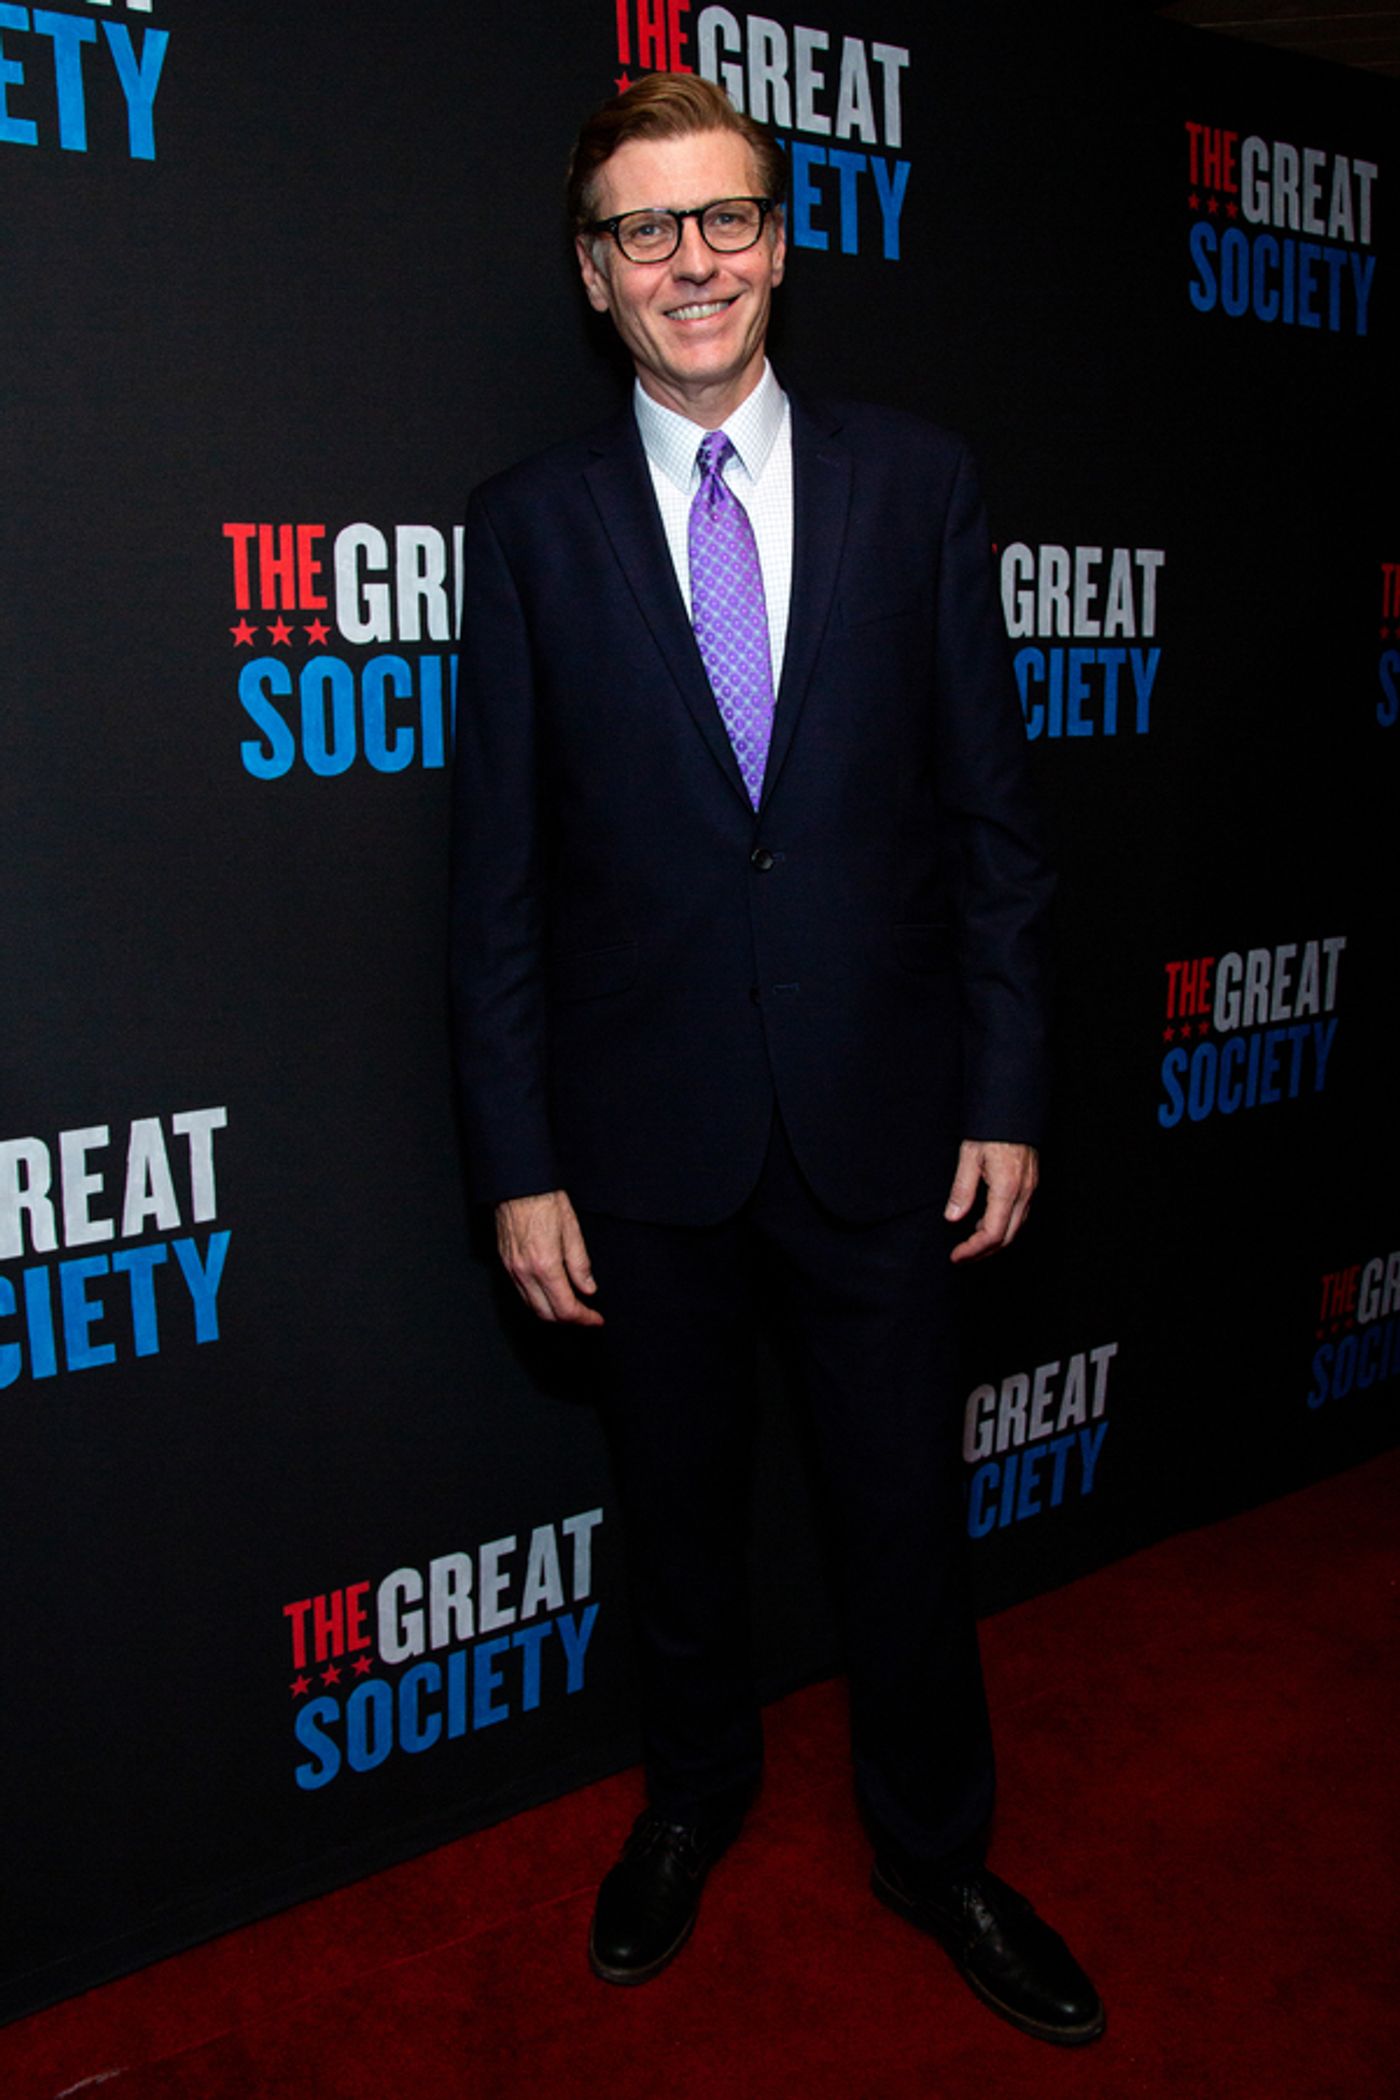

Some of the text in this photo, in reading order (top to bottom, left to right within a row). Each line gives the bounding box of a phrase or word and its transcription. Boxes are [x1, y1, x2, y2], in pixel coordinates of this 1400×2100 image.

[615, 0, 910, 148] THE GREAT
[775, 138, 912, 261] ETY
[1185, 121, 1378, 245] THE GREAT
[1188, 220, 1377, 336] SOCIETY
[222, 522, 328, 611] THE
[1000, 541, 1166, 639] GREAT
[237, 653, 460, 781] SOCI
[1012, 645, 1162, 742] CIETY
[1164, 936, 1347, 1033] THE GREAT
[1157, 1016, 1339, 1129] SOCIETY
[1320, 1264, 1361, 1322] THE
[964, 1342, 1118, 1463] GREAT
[967, 1420, 1109, 1539] CIETY
[282, 1508, 603, 1670] THE GREAT
[293, 1602, 600, 1791] SOCIETY
